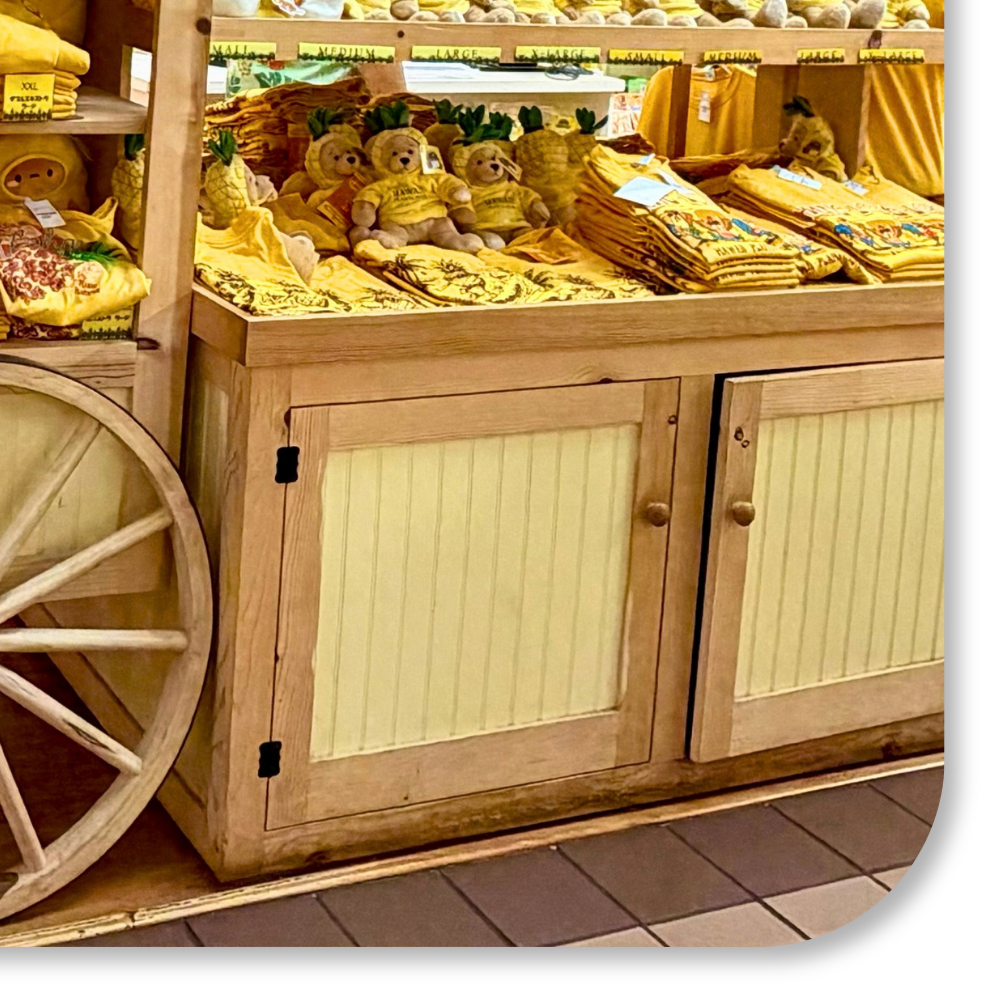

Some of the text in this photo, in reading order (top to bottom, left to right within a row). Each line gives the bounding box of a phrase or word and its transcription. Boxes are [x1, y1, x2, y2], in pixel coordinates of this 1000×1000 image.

[318, 46, 376, 60] MEDIUM
[436, 49, 479, 59] LARGE
[531, 49, 586, 60] X-LARGE
[626, 52, 667, 62] SMALL
[20, 81, 39, 91] XXL
